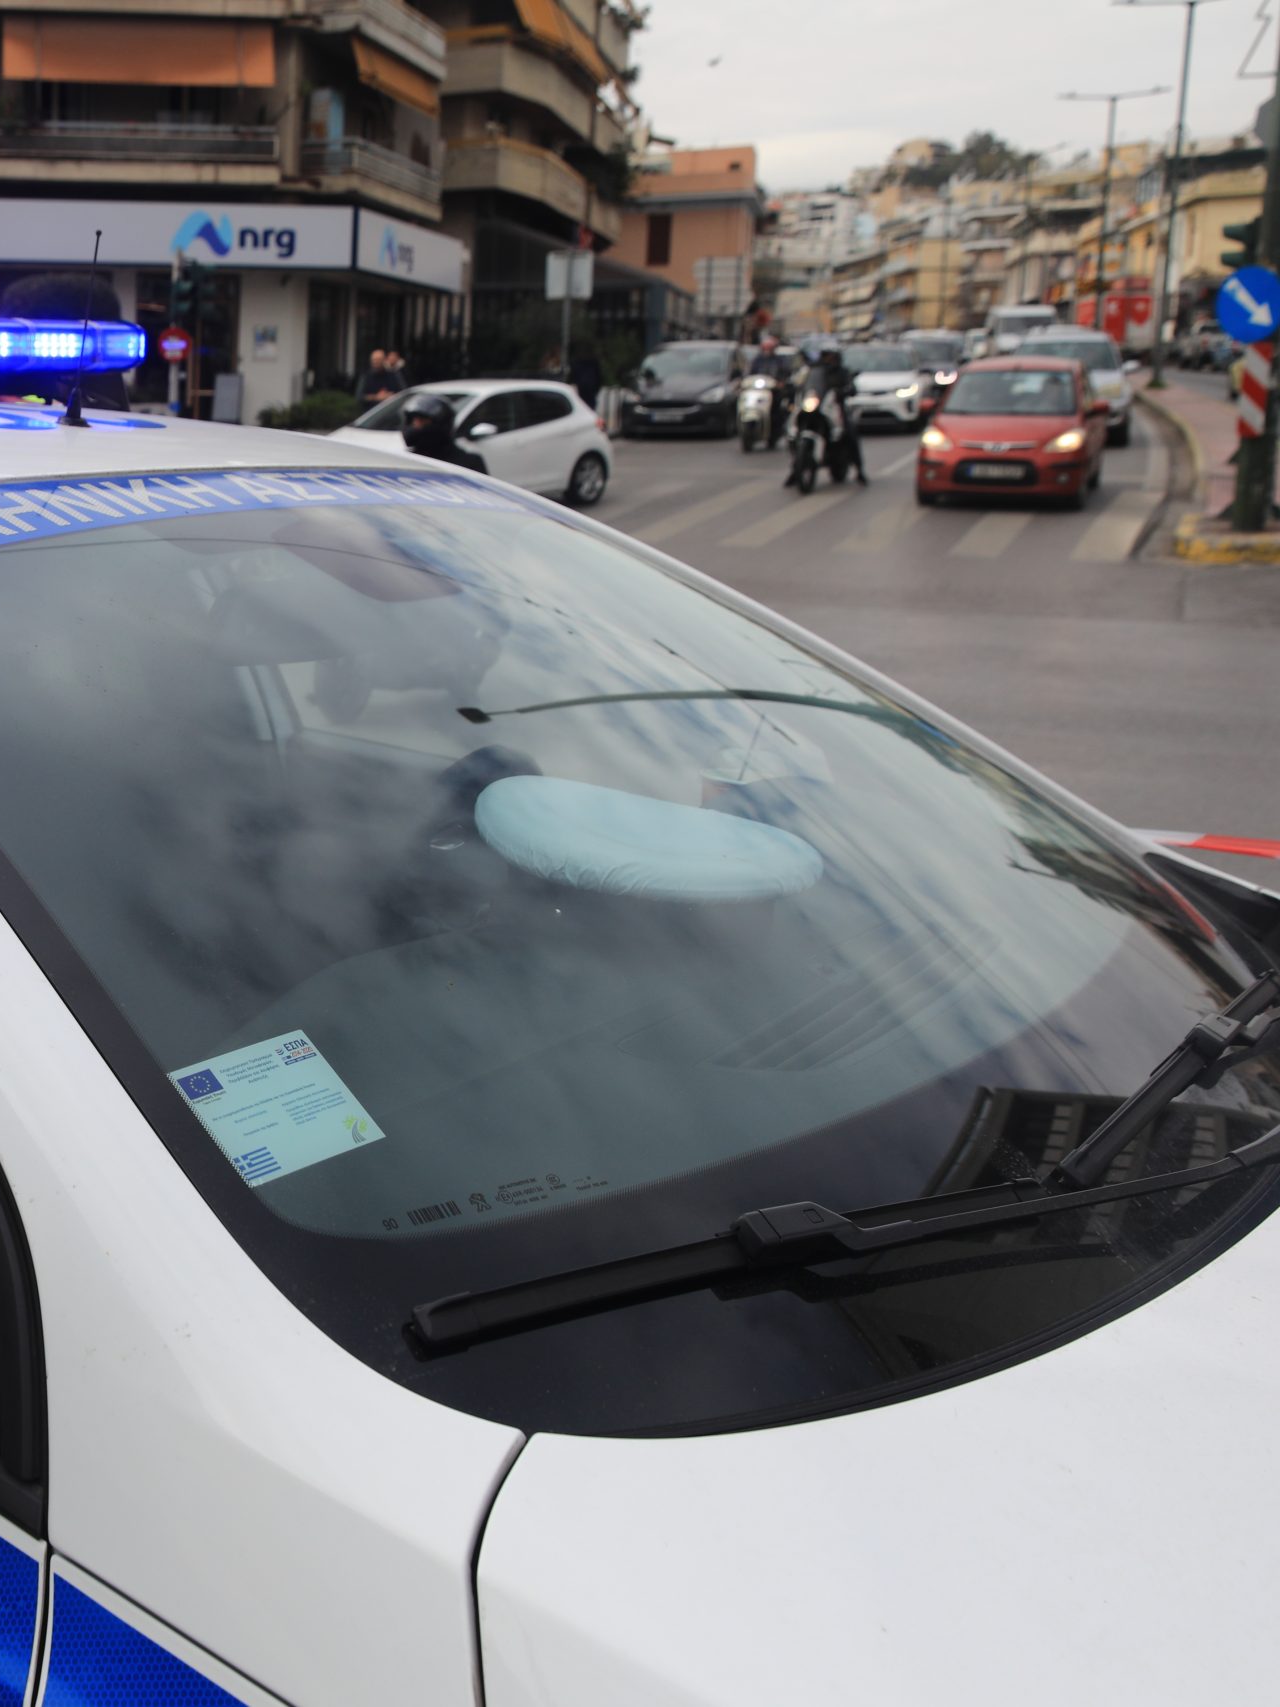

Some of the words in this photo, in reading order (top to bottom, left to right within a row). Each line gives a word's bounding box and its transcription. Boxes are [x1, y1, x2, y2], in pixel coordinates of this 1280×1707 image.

[238, 226, 297, 258] nrg
[222, 472, 520, 510] ΑΣΤΥΝΟ
[283, 1038, 309, 1052] ΕΣΠΑ
[381, 1216, 400, 1232] 90
